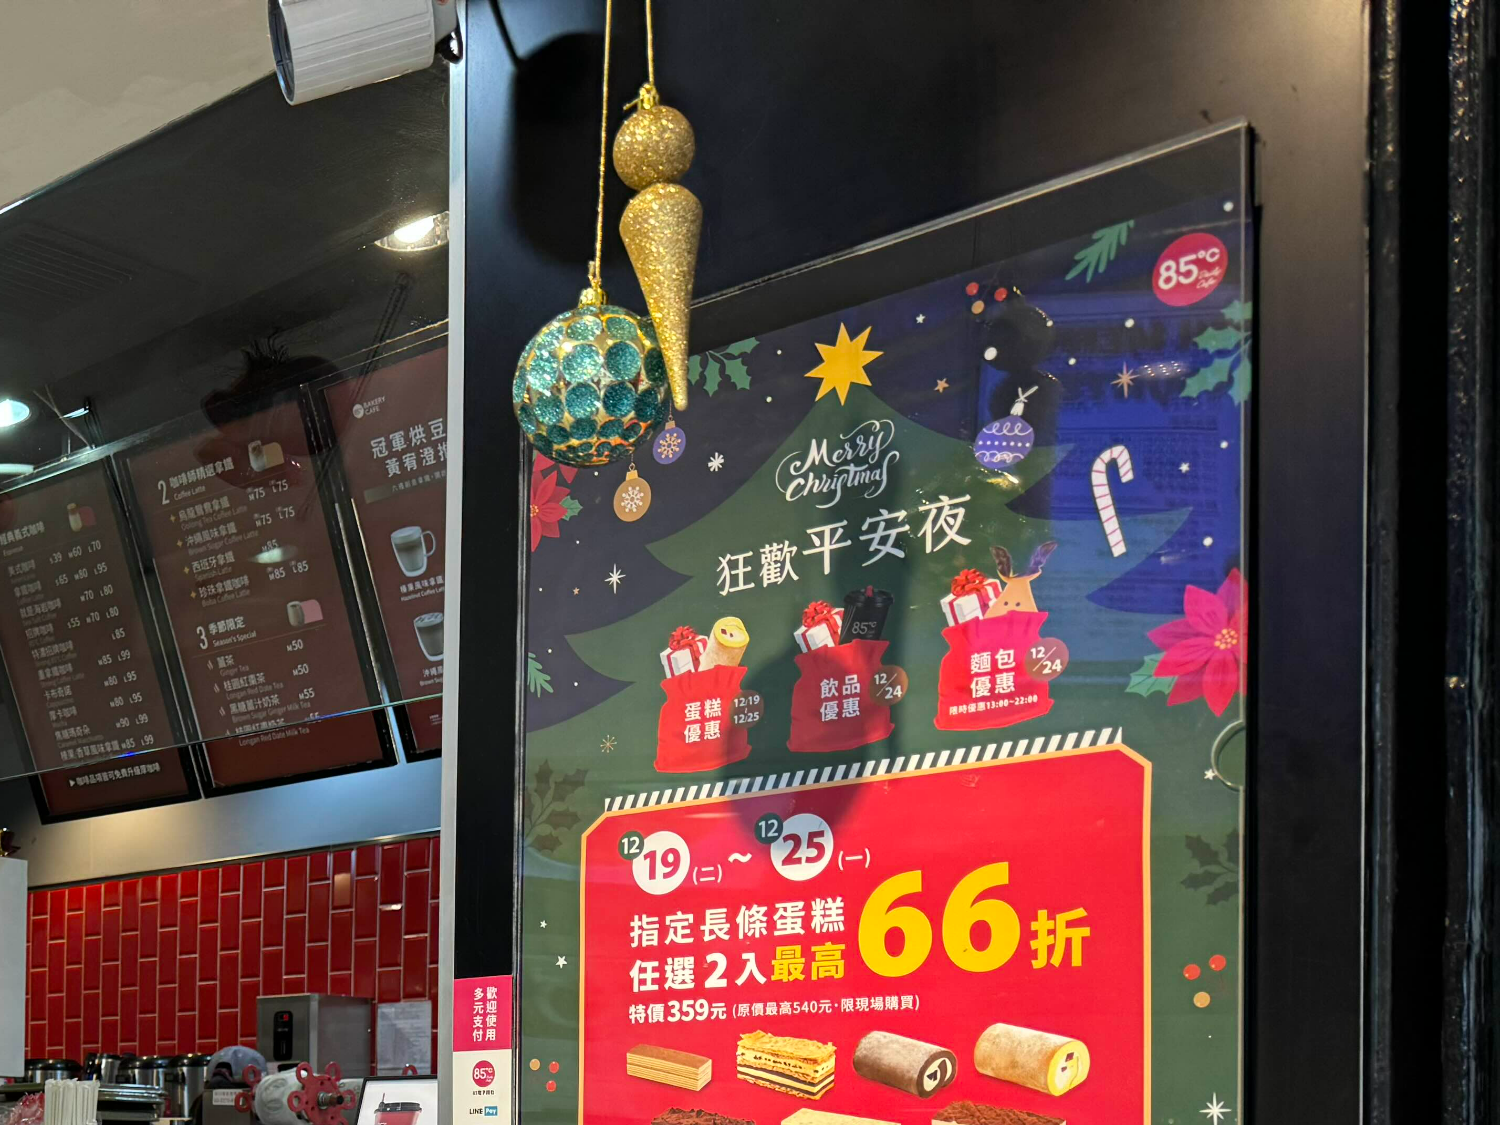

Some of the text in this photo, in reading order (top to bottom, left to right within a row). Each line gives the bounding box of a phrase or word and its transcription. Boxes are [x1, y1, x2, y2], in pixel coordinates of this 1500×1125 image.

[365, 406, 379, 416] CAFE
[370, 418, 446, 459] 冠軍烘豆
[789, 420, 895, 475] Merry
[775, 450, 900, 509] Christmas
[158, 480, 170, 505] 2
[174, 484, 206, 501] Coffee Latte
[716, 494, 972, 596] 狂歡平安夜
[191, 551, 235, 573] 西班牙拿鐵
[197, 616, 246, 650] 3 季節限定
[213, 630, 257, 648] Season's Special
[287, 639, 304, 652] M50
[293, 664, 309, 676] M50
[971, 648, 1015, 674] 麵包
[299, 688, 315, 700] M55
[820, 674, 860, 698] 飲品
[971, 672, 1015, 698] 優惠
[684, 698, 722, 721] 蛋糕
[733, 693, 760, 708] 12/19
[820, 697, 860, 721] 優惠
[949, 694, 1038, 716] 限時優惠13:00~22:00
[733, 711, 760, 724] 12/25
[288, 728, 299, 737] Milk
[299, 727, 310, 736] Tea
[684, 722, 721, 744] 優惠
[621, 836, 640, 855] 12
[642, 848, 681, 881] 19
[758, 819, 778, 838] 12
[781, 829, 826, 867] 25
[629, 896, 846, 948] 指定長條蛋糕
[629, 942, 846, 993] 任選2入最高
[472, 987, 484, 1042] 多元支付
[485, 986, 498, 1041] 歡迎使用
[629, 999, 727, 1024] 特價359元
[485, 1107, 497, 1115] Pay
